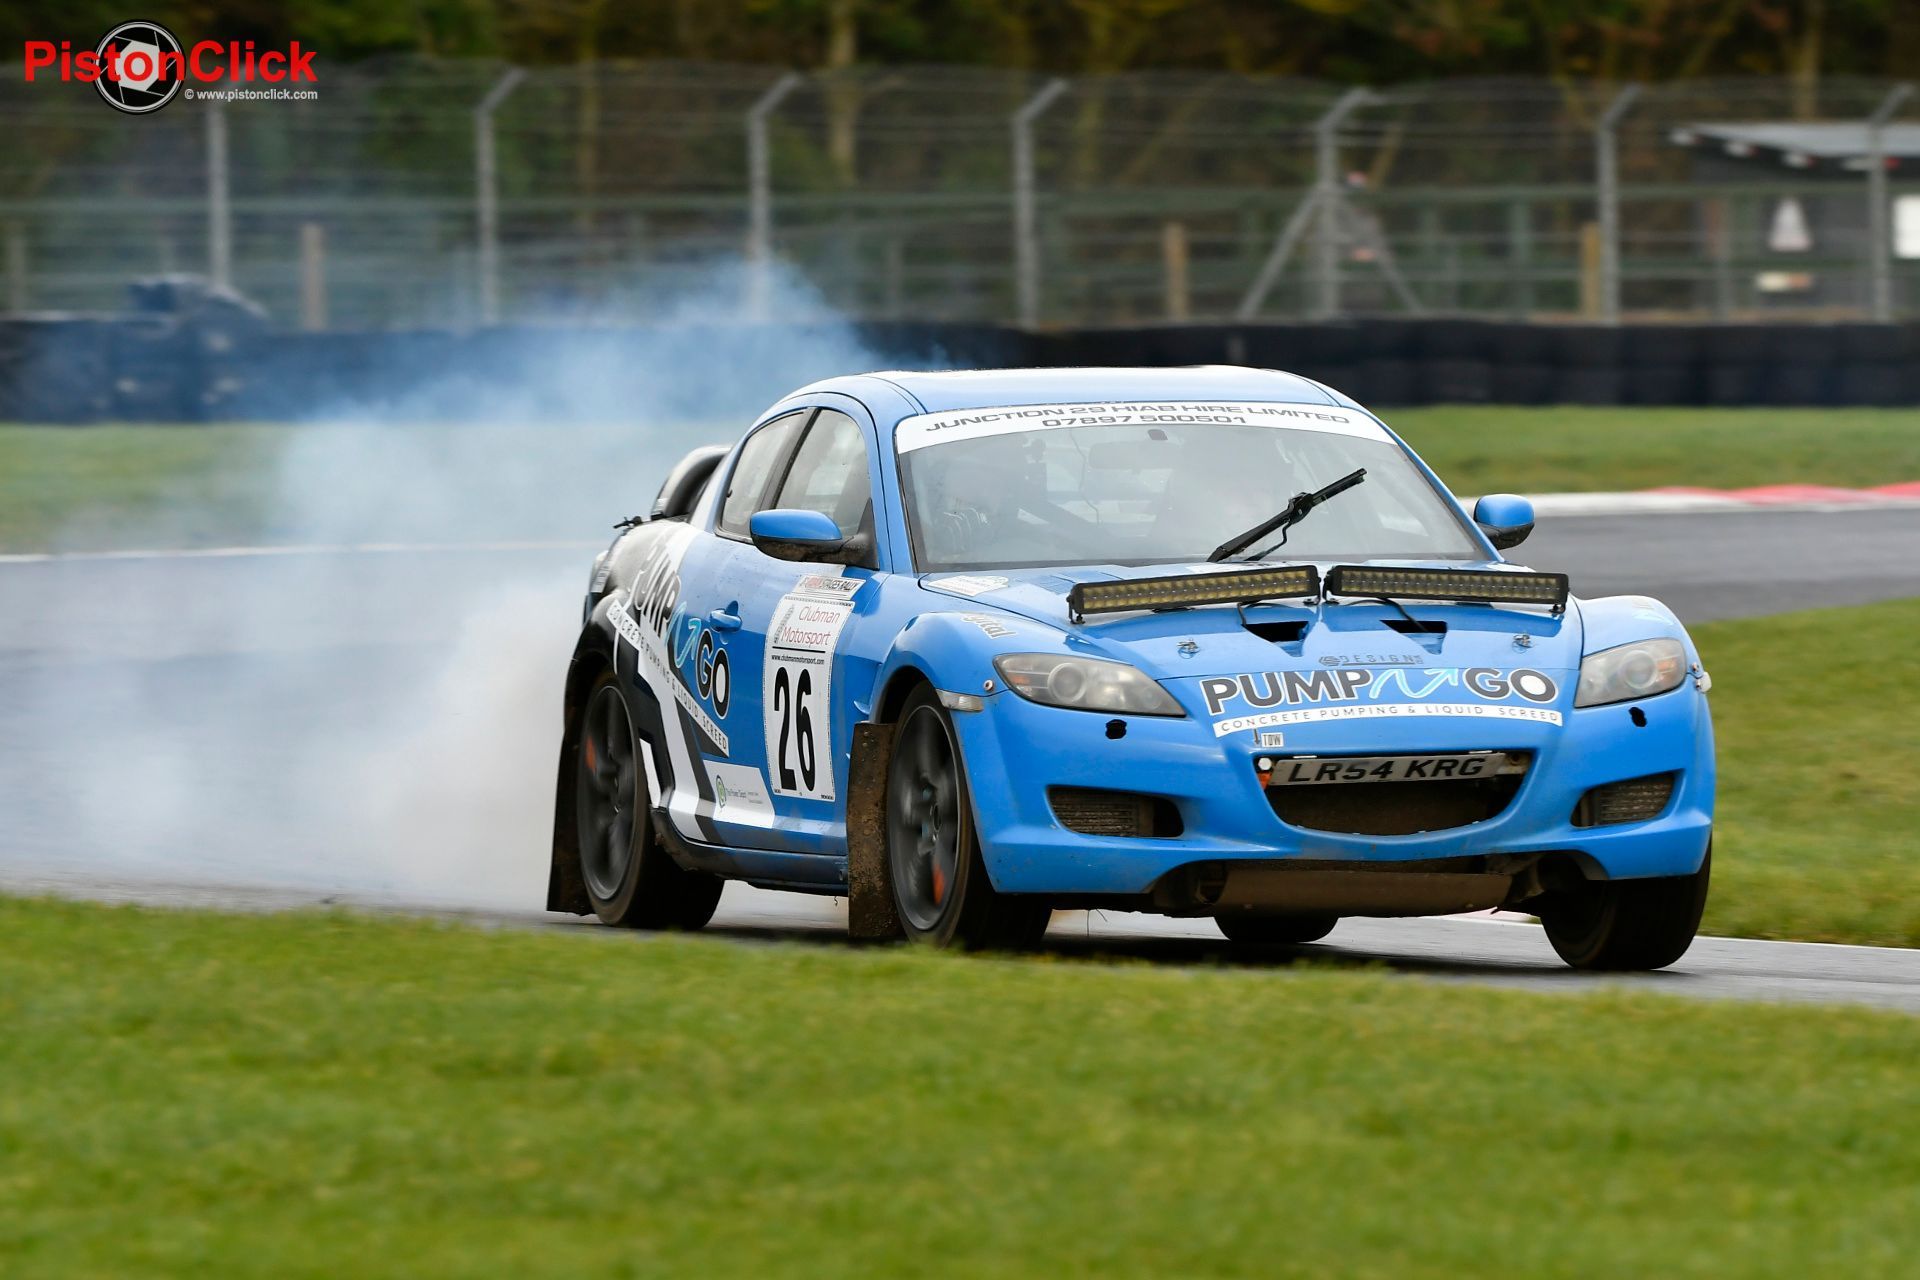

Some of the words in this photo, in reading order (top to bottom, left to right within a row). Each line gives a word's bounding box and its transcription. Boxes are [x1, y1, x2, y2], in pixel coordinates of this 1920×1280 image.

[926, 407, 1065, 432] JUNCTION
[1069, 406, 1106, 414] 29
[1112, 405, 1177, 413] HIAB
[1181, 405, 1243, 413] HIRE
[1248, 407, 1350, 424] LIMITED
[1042, 415, 1132, 427] 07897
[1140, 414, 1246, 424] 500501
[799, 605, 841, 624] Clubman
[781, 626, 831, 649] Motorsport
[696, 628, 731, 720] GO
[1200, 669, 1374, 717] PUMP
[1462, 668, 1559, 704] GO
[676, 686, 699, 719] LIQUID
[702, 720, 727, 751] SCREED
[774, 666, 816, 792] 26
[1221, 711, 1310, 732] CONCRETE
[1320, 705, 1398, 718] PUMPING
[1407, 705, 1416, 714] &
[1425, 705, 1484, 715] LIQUID
[1499, 707, 1559, 721] SCREED
[1262, 733, 1282, 747] TOW
[1287, 760, 1395, 783] LR54
[1402, 757, 1487, 779] KRG
